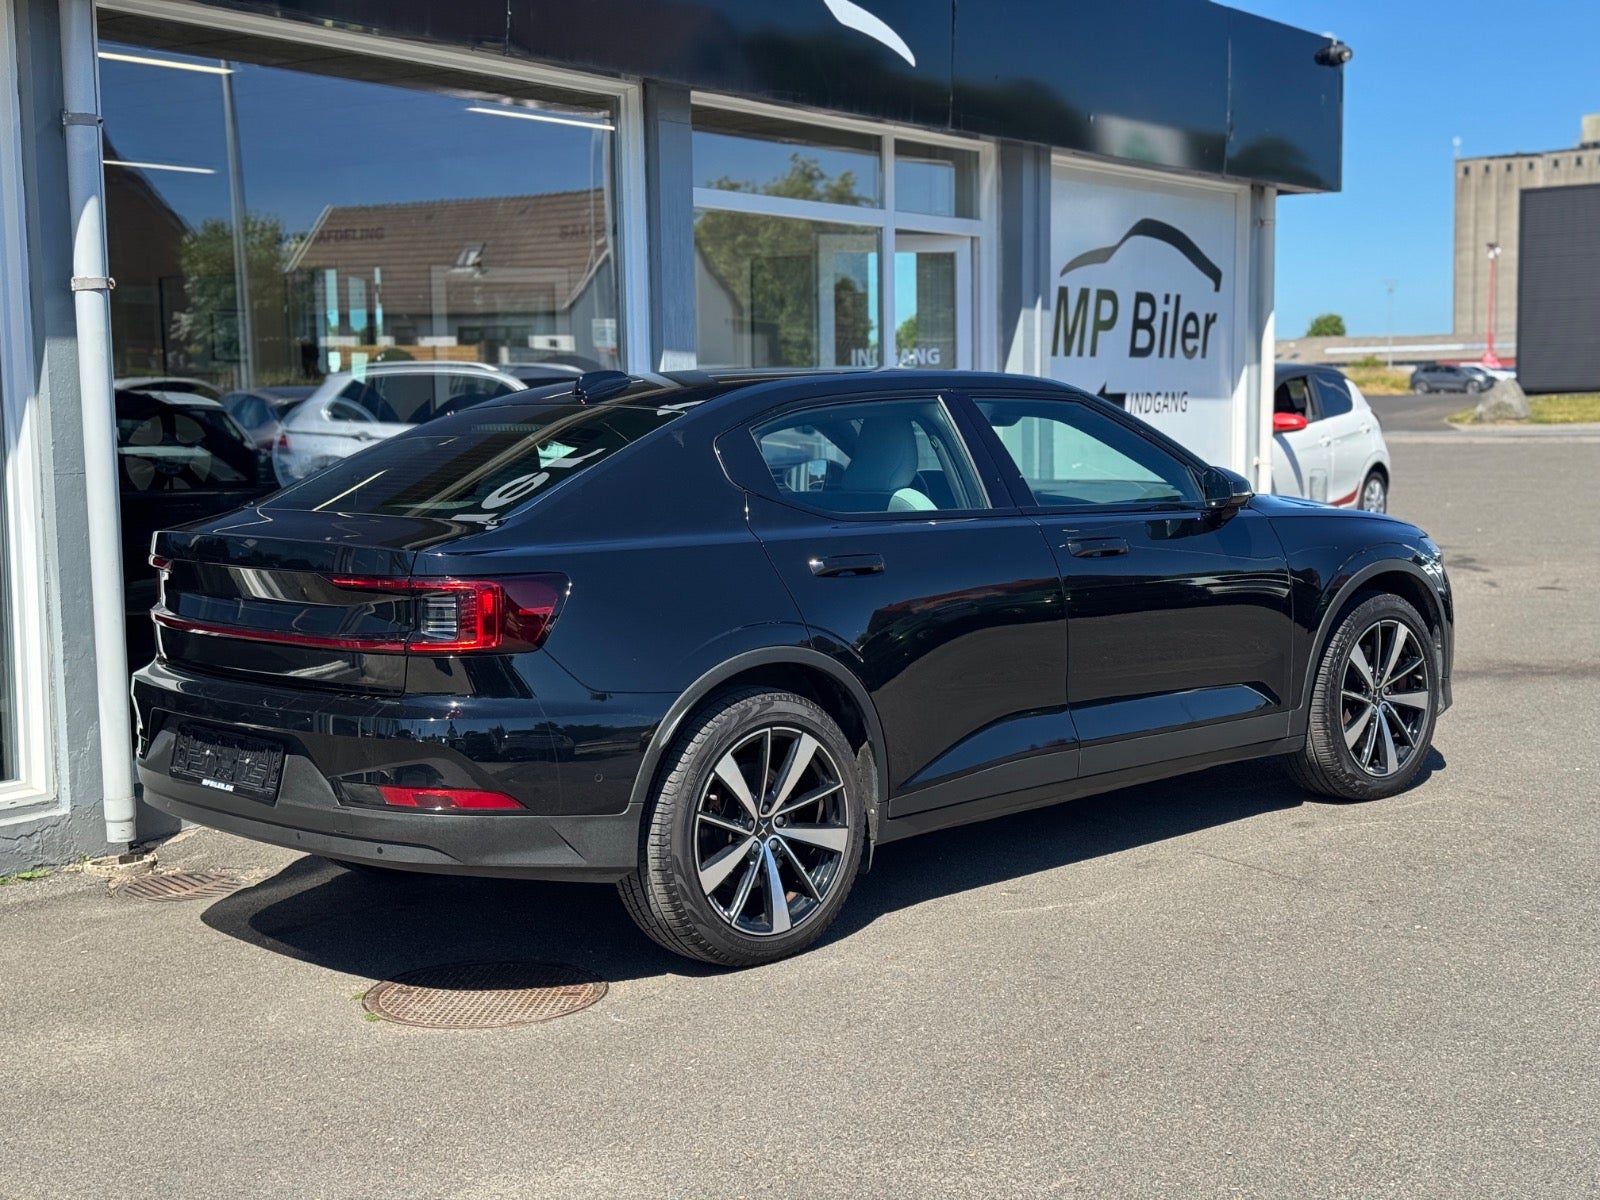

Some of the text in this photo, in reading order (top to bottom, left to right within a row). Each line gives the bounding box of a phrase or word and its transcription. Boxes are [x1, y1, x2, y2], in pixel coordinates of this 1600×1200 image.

[1051, 286, 1218, 360] MP Biler
[851, 348, 940, 366] INDANG
[1129, 391, 1189, 414] INDGANG
